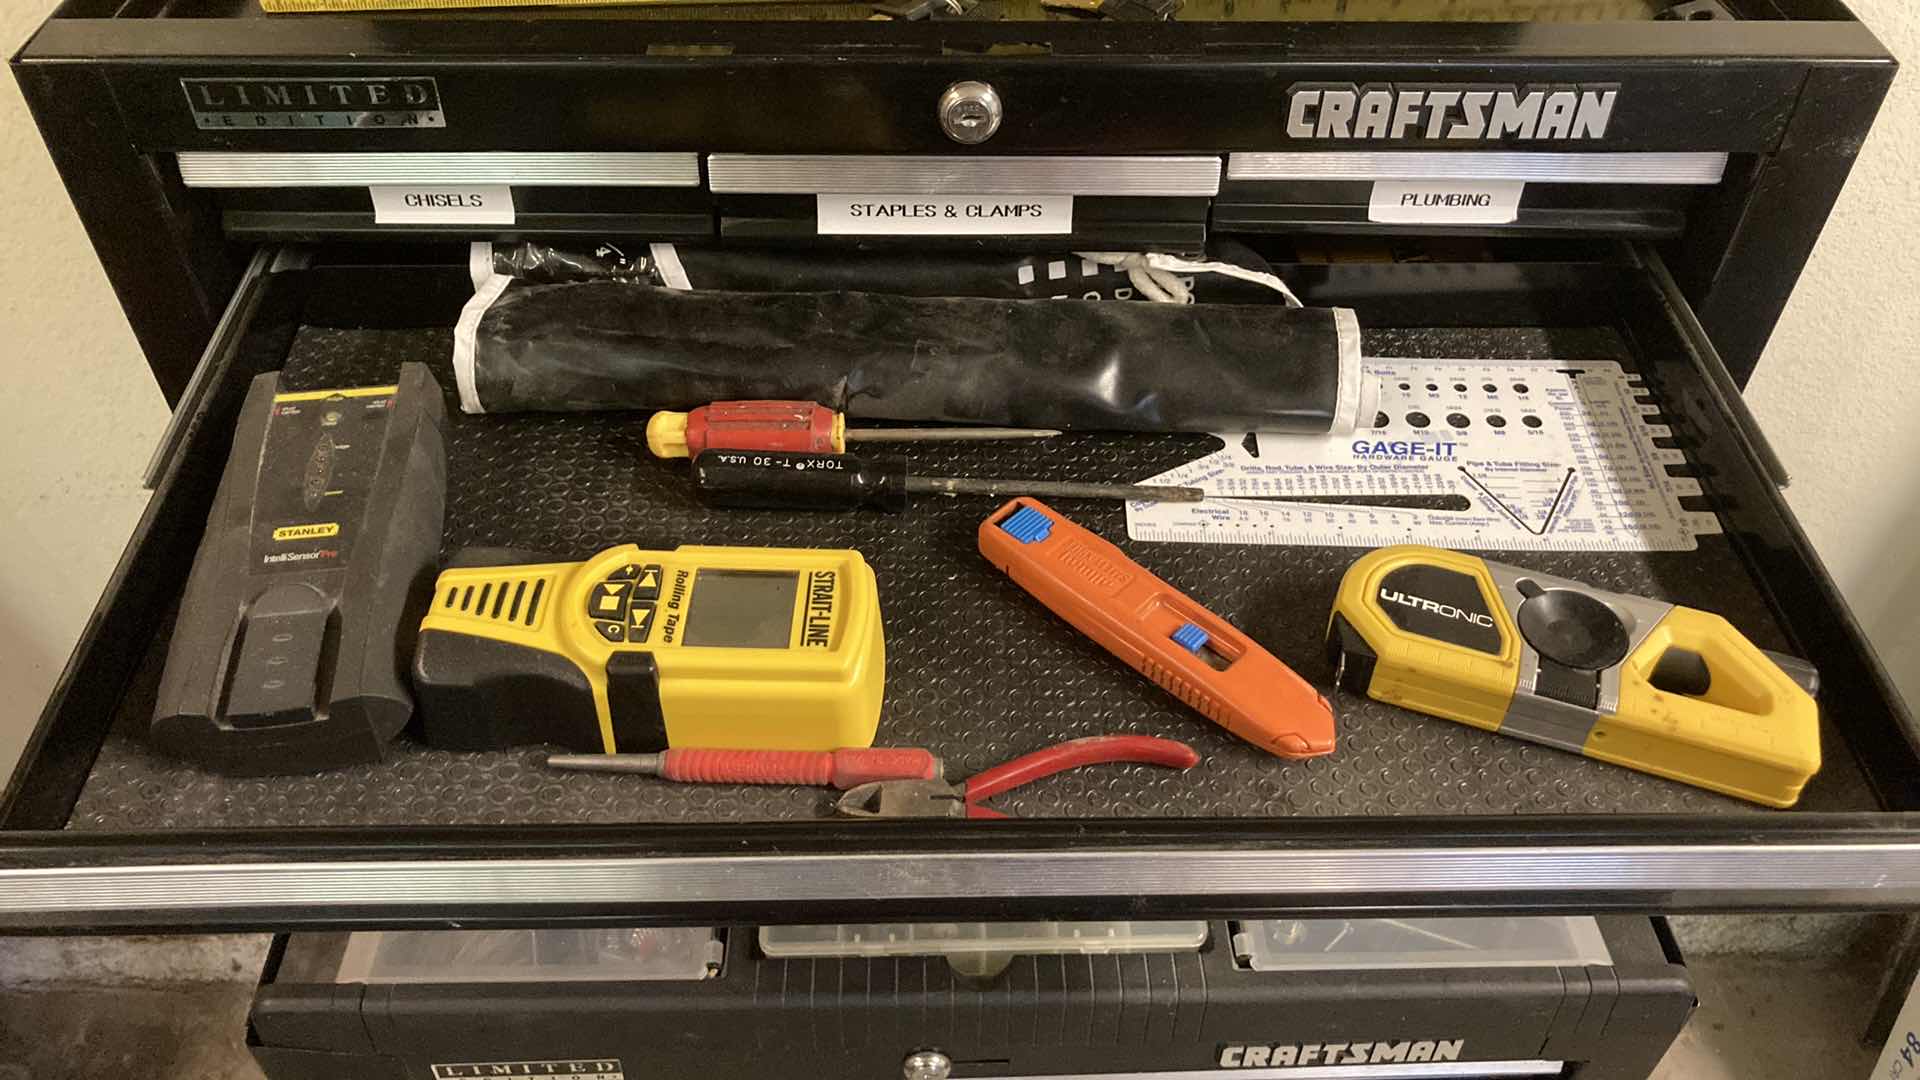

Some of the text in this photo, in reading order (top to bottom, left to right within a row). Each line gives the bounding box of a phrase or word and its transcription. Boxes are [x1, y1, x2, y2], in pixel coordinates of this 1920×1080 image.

[200, 84, 427, 105] LIMITED
[222, 112, 419, 126] EDITION
[1286, 88, 1618, 139] CRAFTSMAN
[404, 194, 483, 208] CHISELS
[1400, 193, 1492, 207] PLUMBING
[850, 203, 1042, 217] STAPLES & CLAMPS
[1351, 440, 1458, 456] GAGE-IT
[1352, 453, 1459, 462] HARDWARE GAUGE
[278, 525, 334, 538] STANLEY
[663, 569, 690, 644] Rolling Tape
[806, 571, 836, 648] STRAIT-LINE
[1380, 587, 1494, 628] ULTRONIC
[1219, 1038, 1464, 1068] CRAFTSMAN
[446, 1061, 616, 1077] LIMITED
